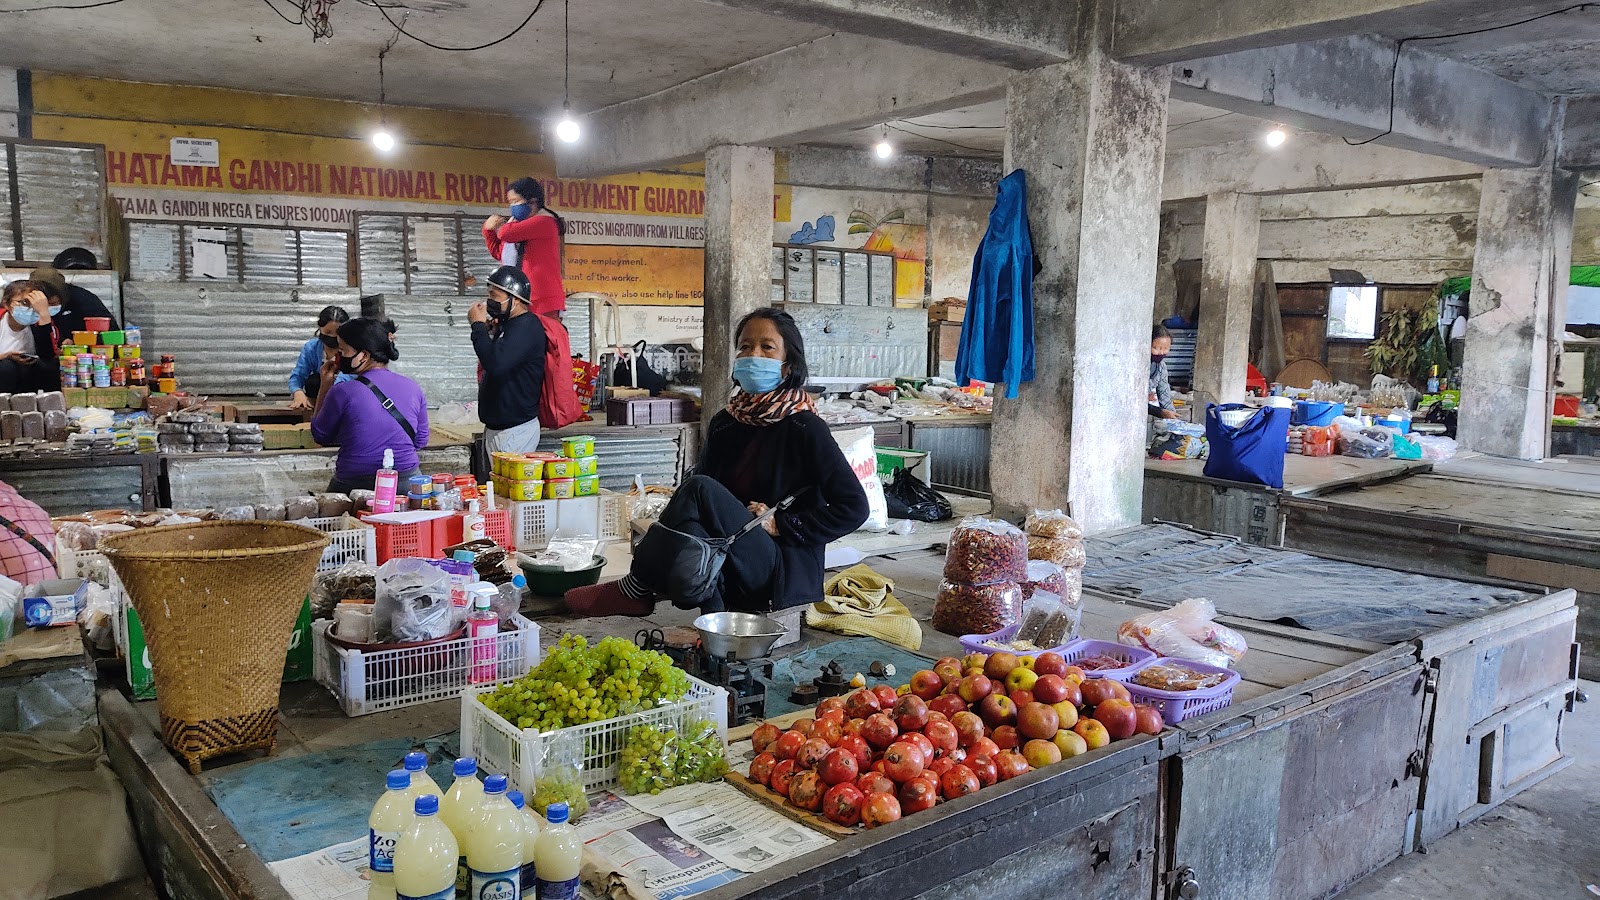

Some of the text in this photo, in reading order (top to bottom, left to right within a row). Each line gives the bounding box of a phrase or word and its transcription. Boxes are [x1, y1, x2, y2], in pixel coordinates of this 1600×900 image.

[105, 151, 223, 188] HATAMA
[229, 158, 321, 193] GANDHI
[329, 164, 441, 200] NATIONAL
[540, 179, 639, 211] PLOYMENT
[644, 186, 705, 214] GUARAN
[116, 197, 158, 215] TAMA
[162, 199, 210, 217] GANDHI
[213, 202, 252, 219] NREGA
[256, 204, 308, 221] ENSURES
[310, 206, 329, 222] 100
[605, 222, 645, 237] MIGRATION
[647, 224, 667, 238] FROM
[669, 225, 704, 240] VILLAGES
[591, 257, 647, 266] employment.
[586, 273, 594, 281] of
[596, 273, 609, 281] the
[611, 273, 642, 282] worker.
[621, 288, 638, 298] also
[657, 289, 673, 300] help
[675, 290, 689, 299] line
[690, 290, 704, 299] 180
[657, 315, 704, 324] Ministry of Rura
[484, 889, 513, 900] OASIS
